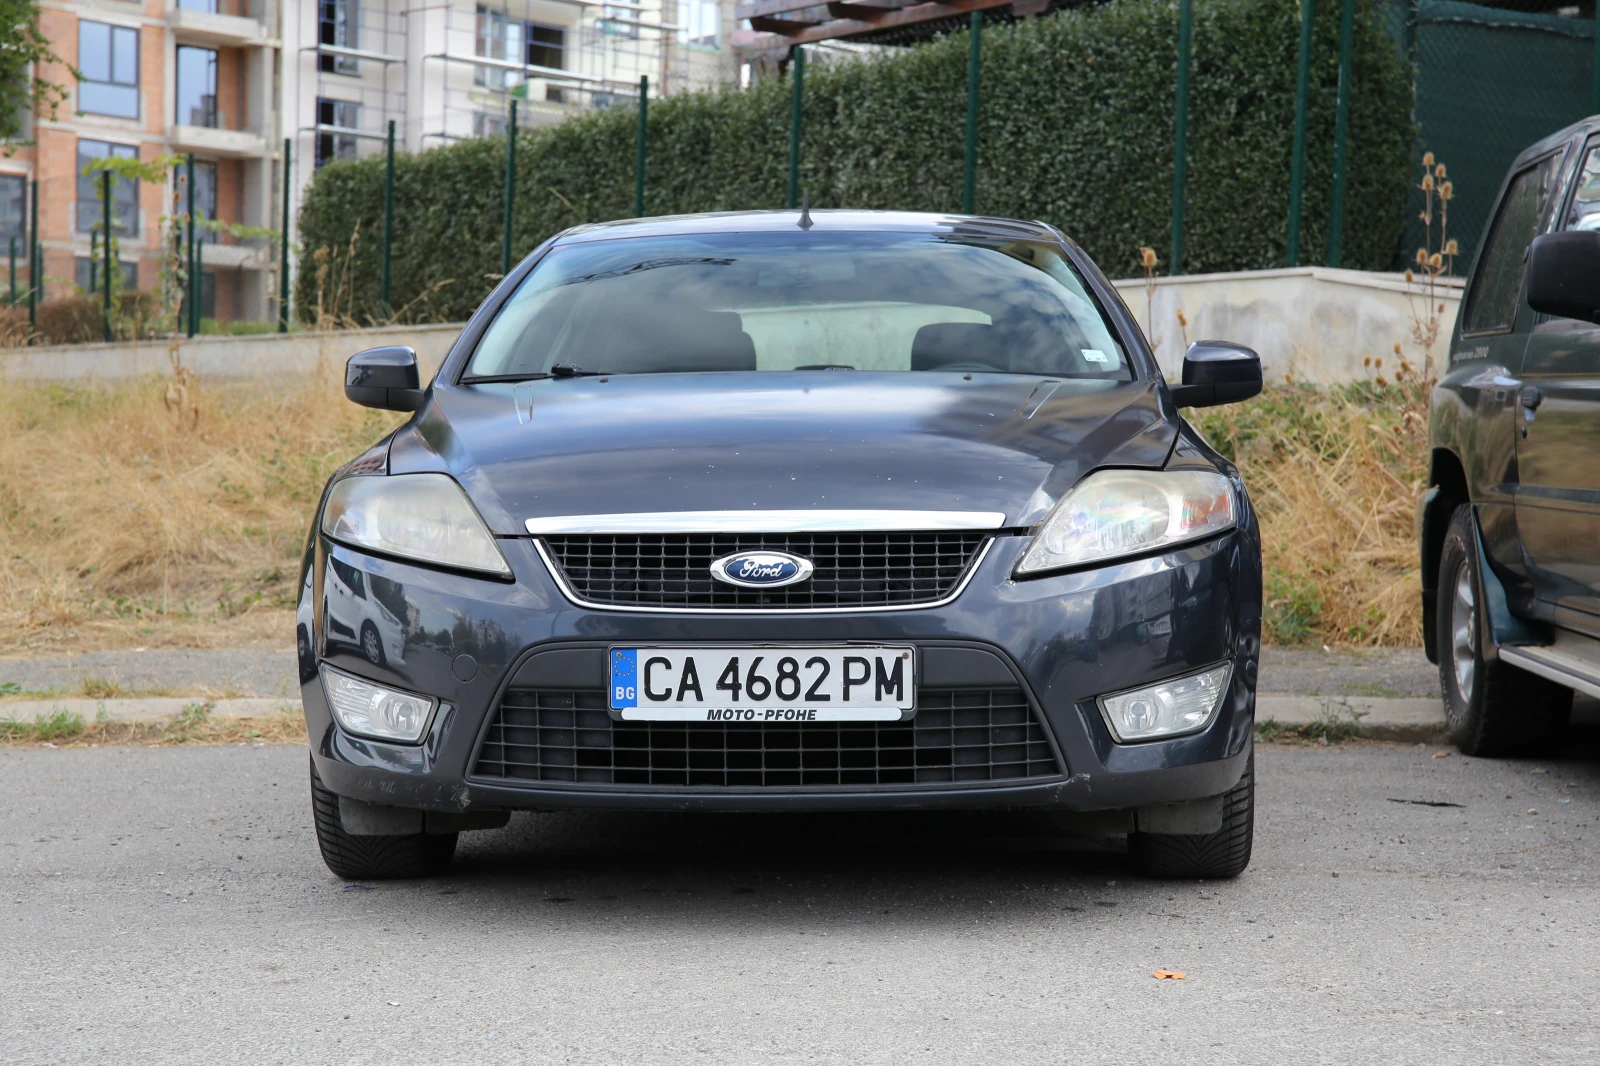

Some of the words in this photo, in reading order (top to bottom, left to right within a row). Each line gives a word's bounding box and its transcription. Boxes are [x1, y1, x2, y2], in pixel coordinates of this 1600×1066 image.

[740, 559, 784, 577] Ford
[644, 656, 704, 702] CA
[716, 656, 831, 702] 4682
[842, 656, 903, 702] PM
[615, 686, 635, 700] BG
[706, 709, 817, 721] MOTO-PFOHE
